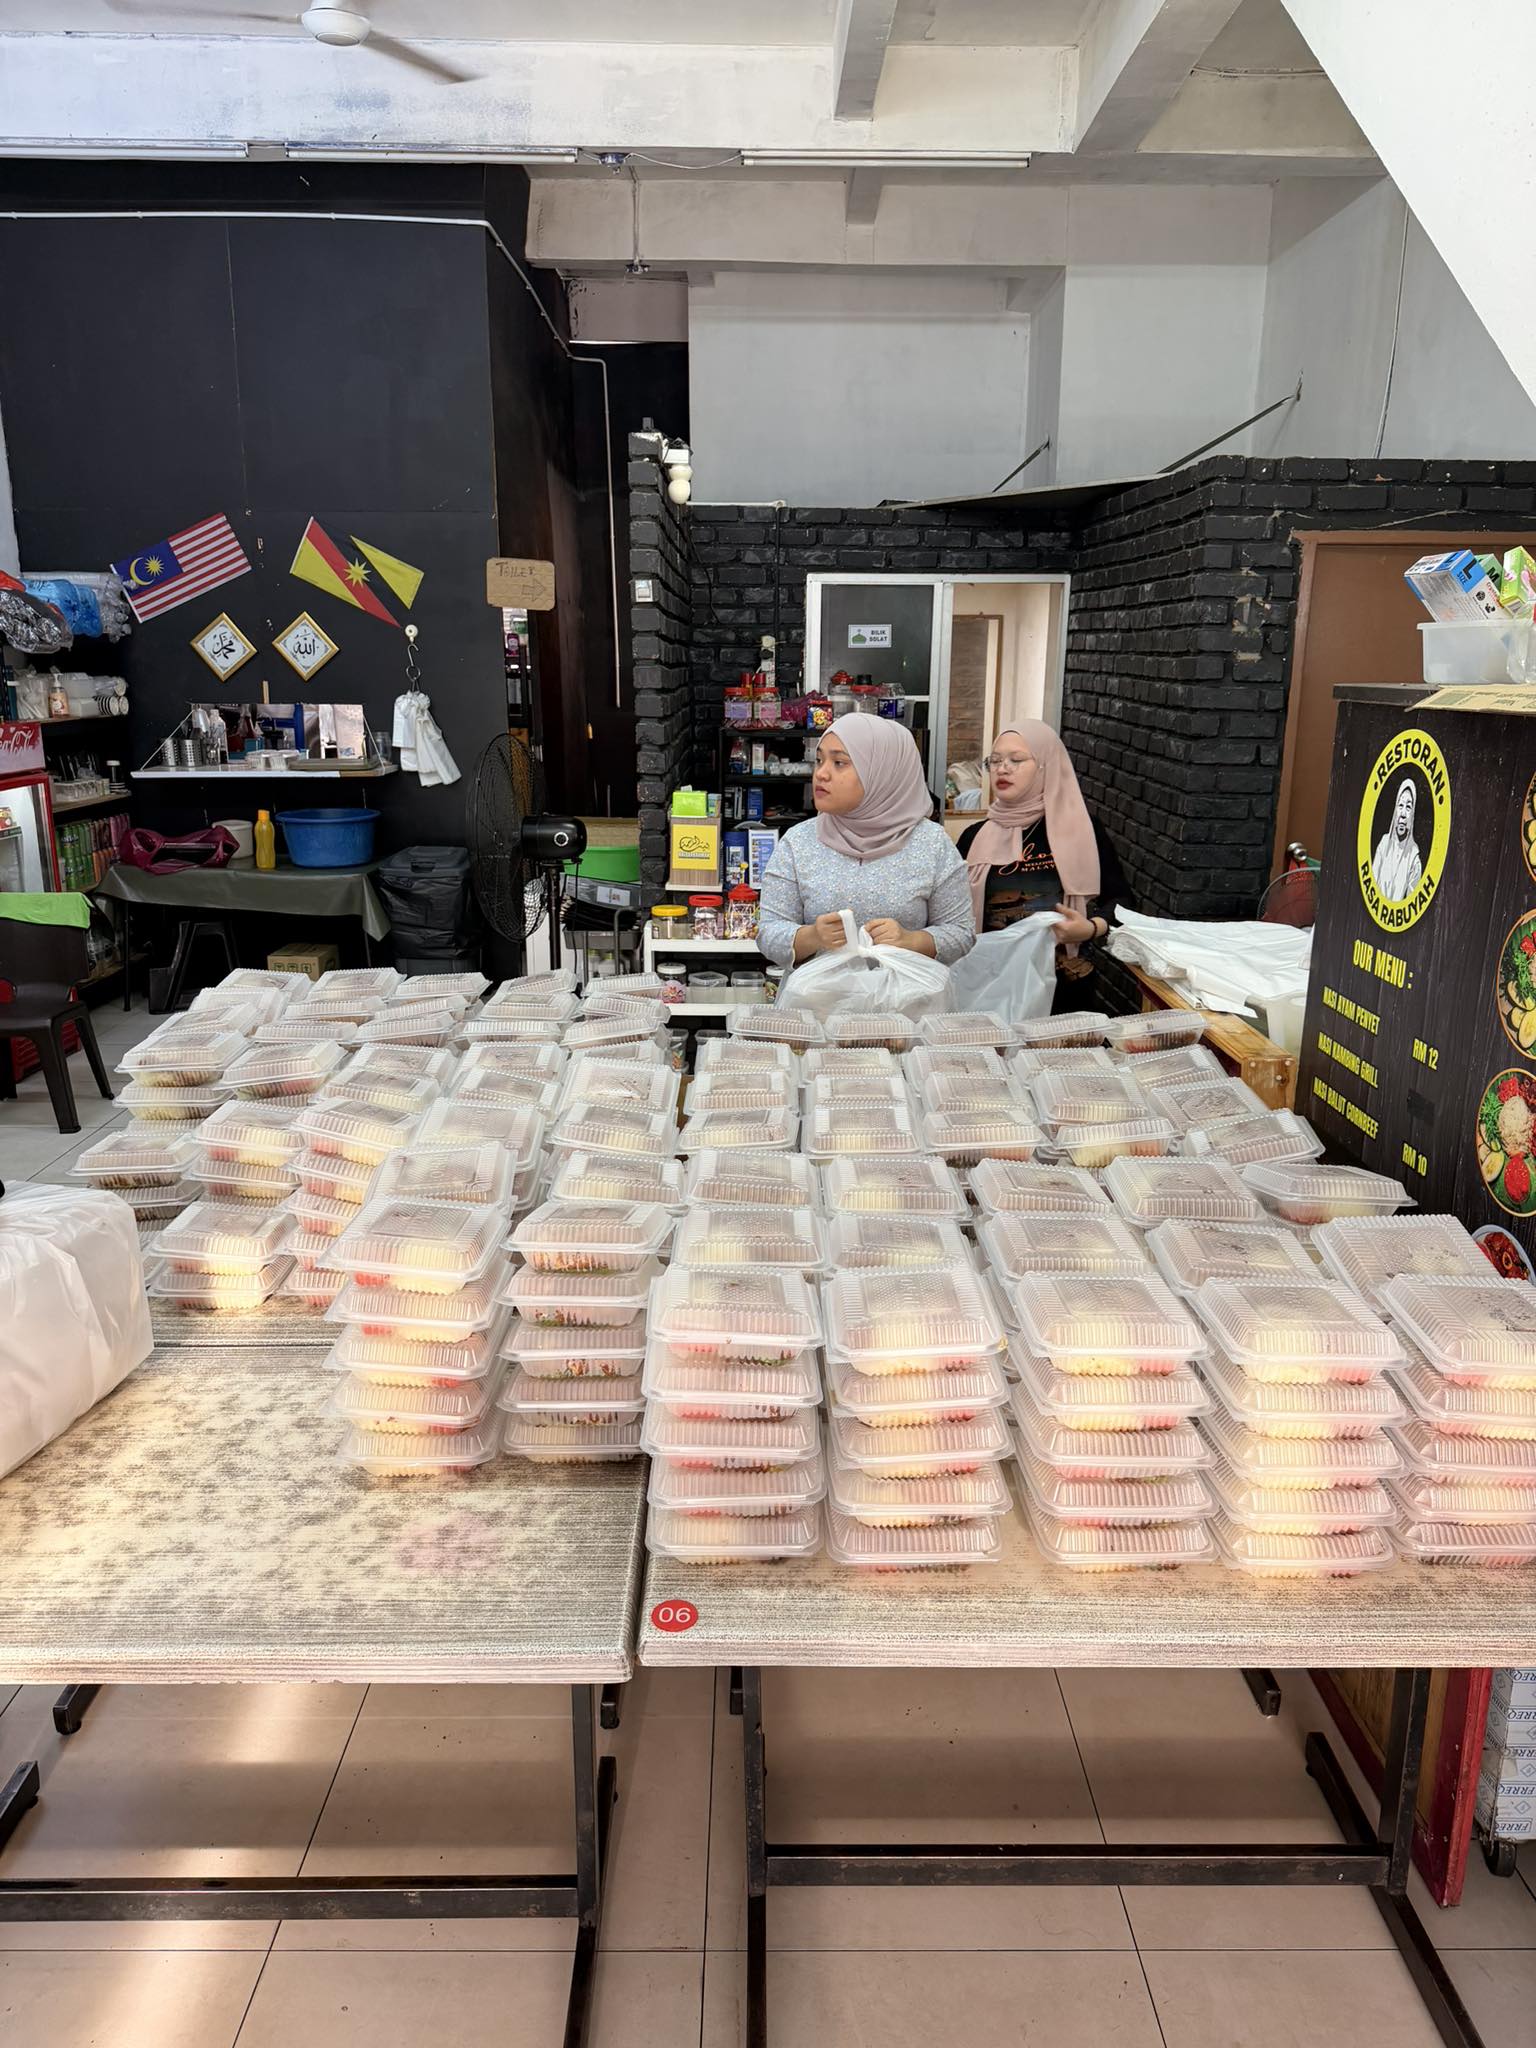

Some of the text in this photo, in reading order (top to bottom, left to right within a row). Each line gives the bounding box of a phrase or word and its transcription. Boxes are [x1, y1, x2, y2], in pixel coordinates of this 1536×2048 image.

[1463, 558, 1477, 580] L
[1486, 566, 1500, 583] M
[1377, 738, 1445, 795] RESTORAN
[1360, 860, 1435, 928] RASA RABUYAH
[1353, 939, 1373, 972] OUR
[1374, 949, 1407, 988] MENU
[1323, 986, 1380, 1035] NASI AYAM PENYET
[1318, 1031, 1378, 1088] NASI KAMBING GRILL
[1412, 1038, 1439, 1070] RM 12
[1313, 1076, 1379, 1139] NASI BALUT CORNBEEF
[1402, 1143, 1428, 1177] RM 10
[658, 1607, 691, 1623] 06
